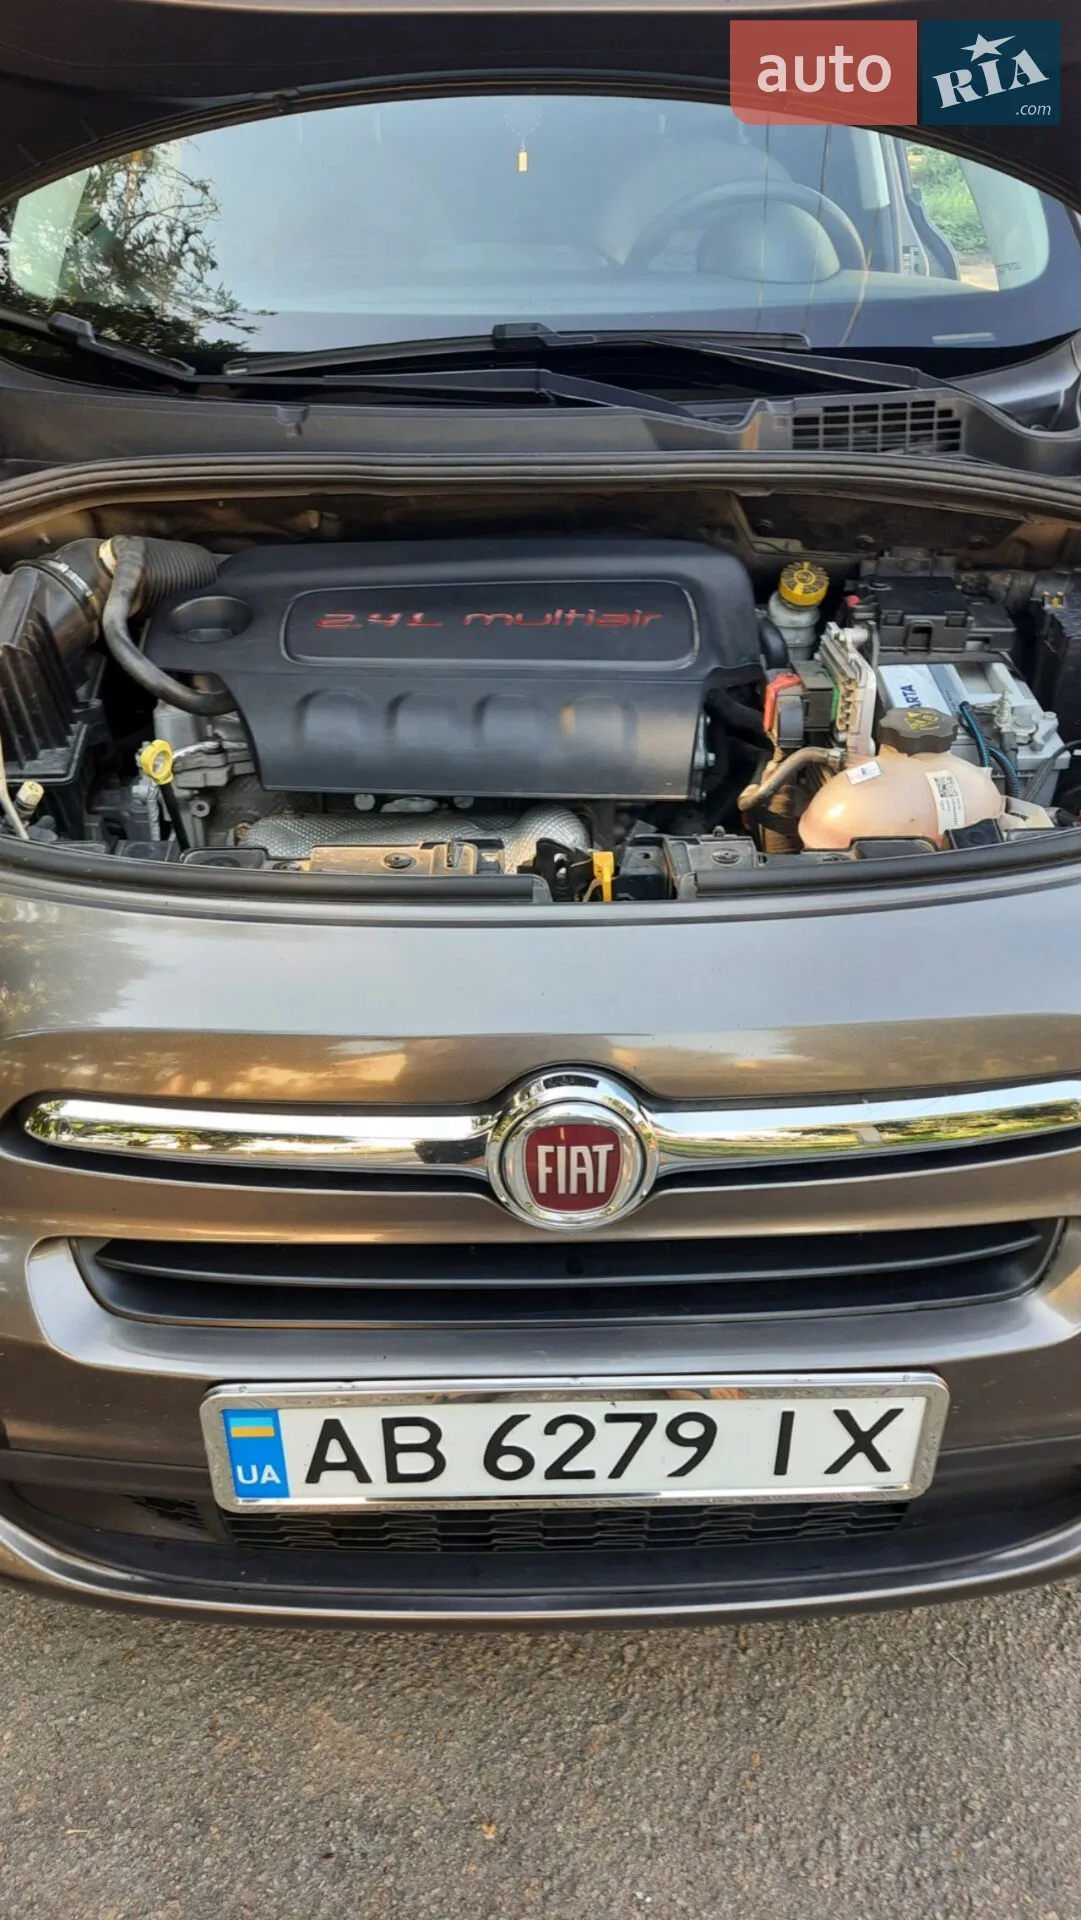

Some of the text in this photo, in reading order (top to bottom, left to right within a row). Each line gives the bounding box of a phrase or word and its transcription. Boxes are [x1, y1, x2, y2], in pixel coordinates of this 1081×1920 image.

[463, 608, 663, 628] multiair
[900, 684, 922, 709] ARTA
[537, 1144, 615, 1195] FIAT
[305, 1408, 905, 1484] AB 6279 IX
[236, 1464, 281, 1485] UA
